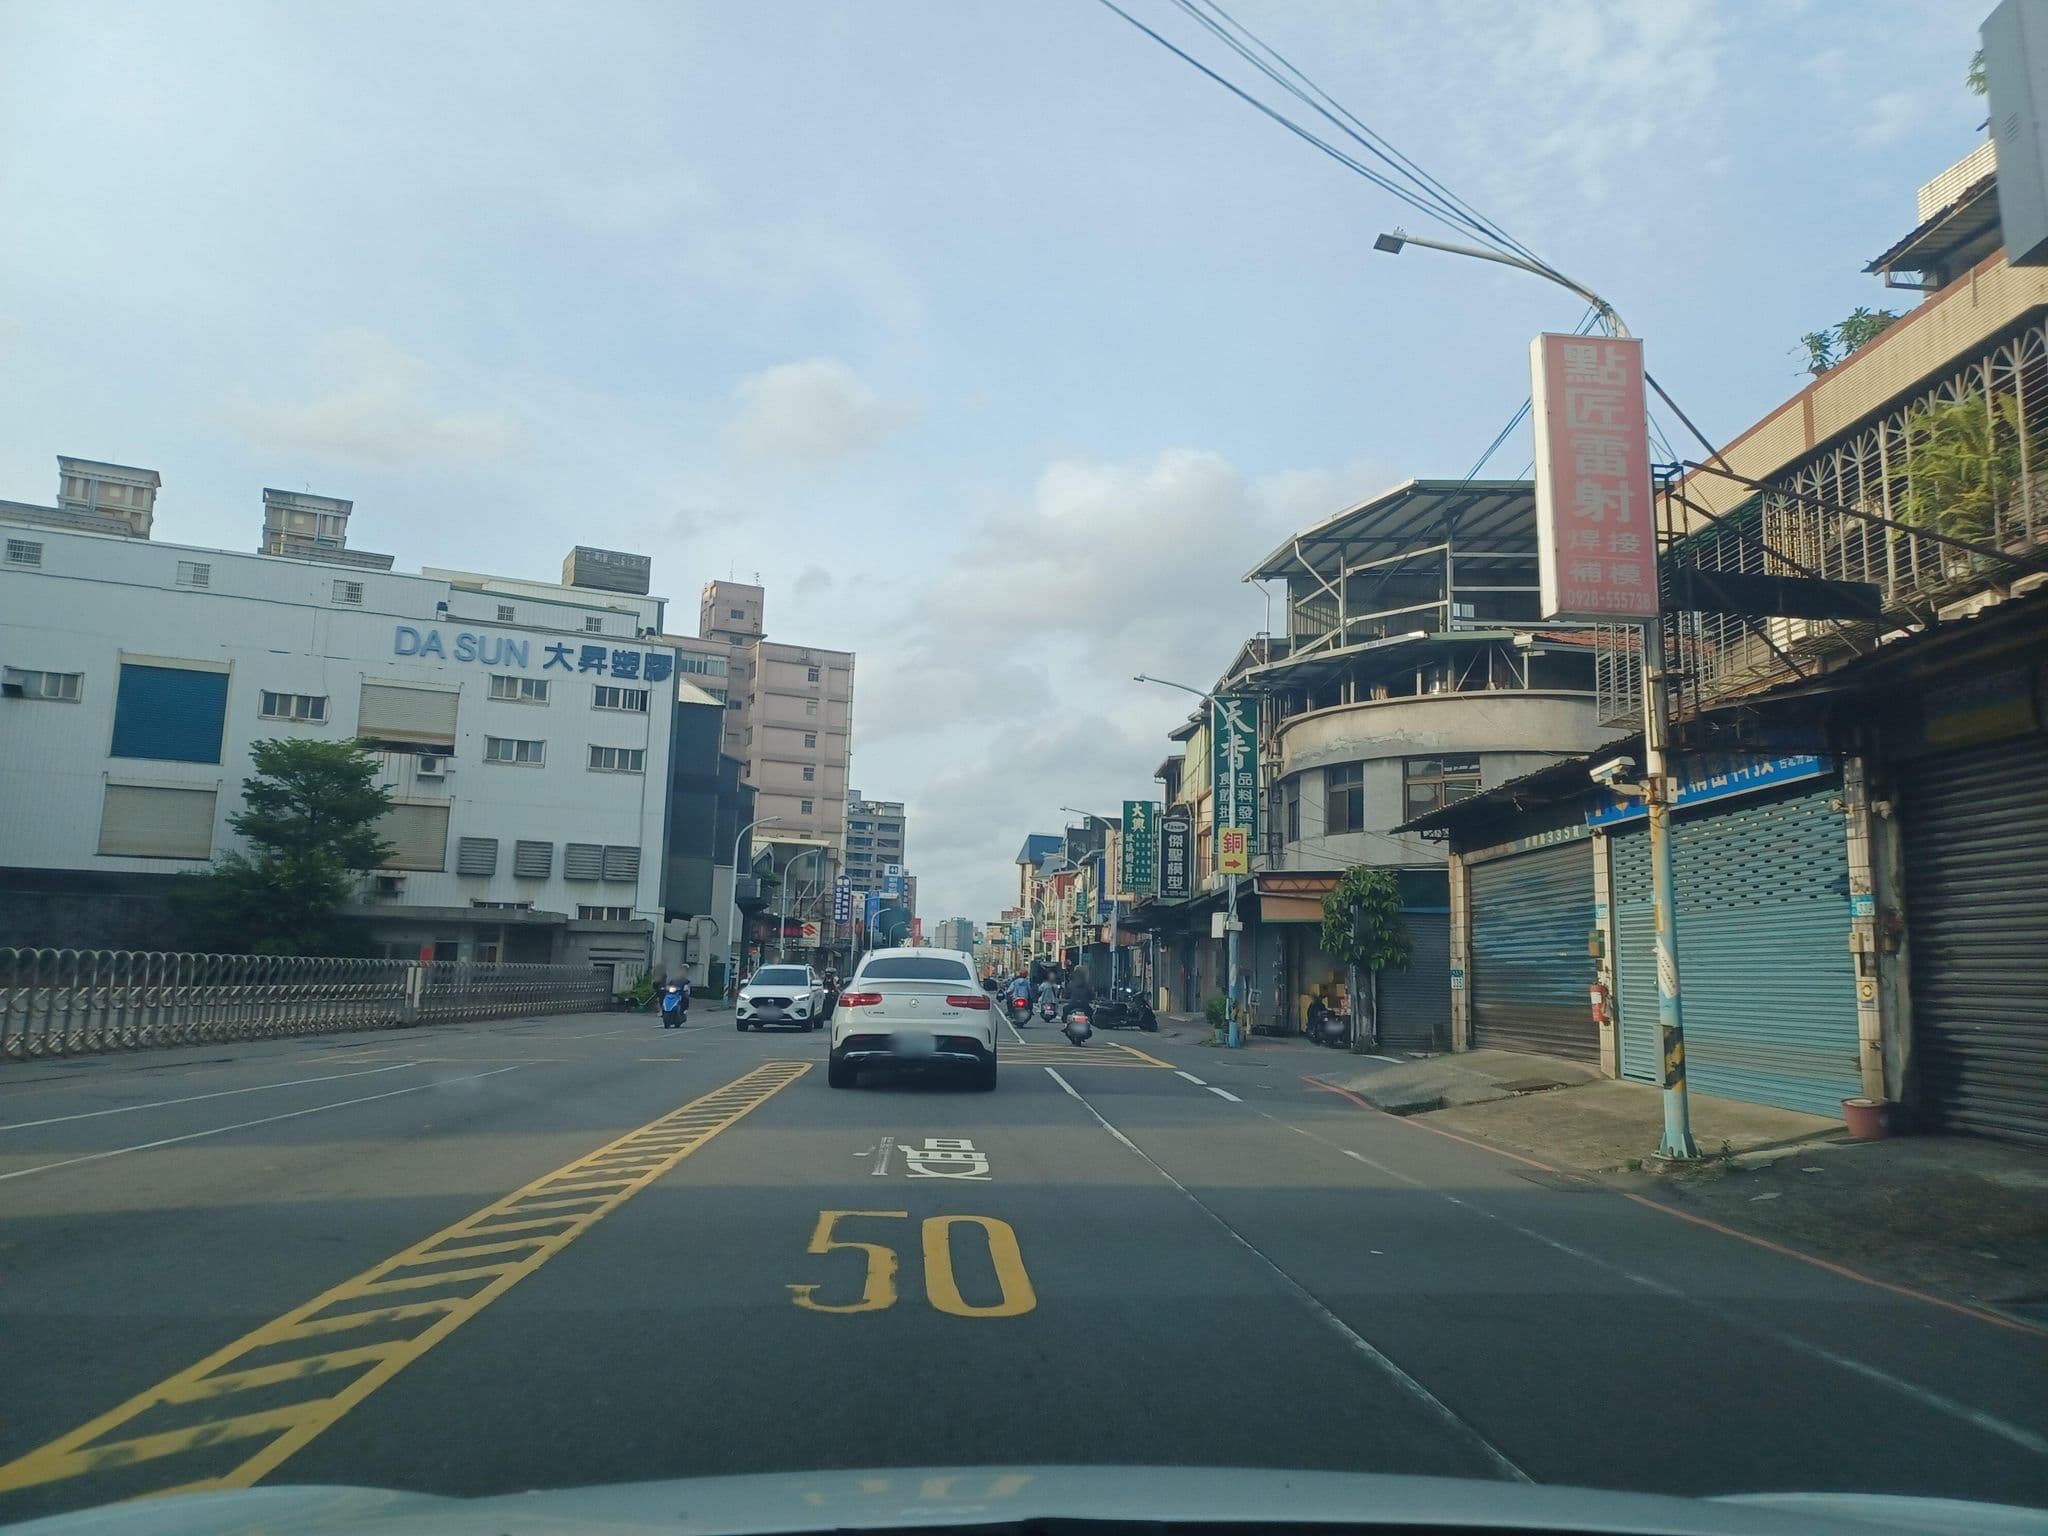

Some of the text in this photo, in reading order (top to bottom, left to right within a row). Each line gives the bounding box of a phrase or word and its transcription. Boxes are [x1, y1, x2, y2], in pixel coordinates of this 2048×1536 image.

[1563, 343, 1634, 523] 點匠雷射
[394, 626, 445, 659] DA
[453, 632, 529, 668] SUN
[1223, 832, 1244, 854] 銅
[785, 1210, 1037, 1318] 50
